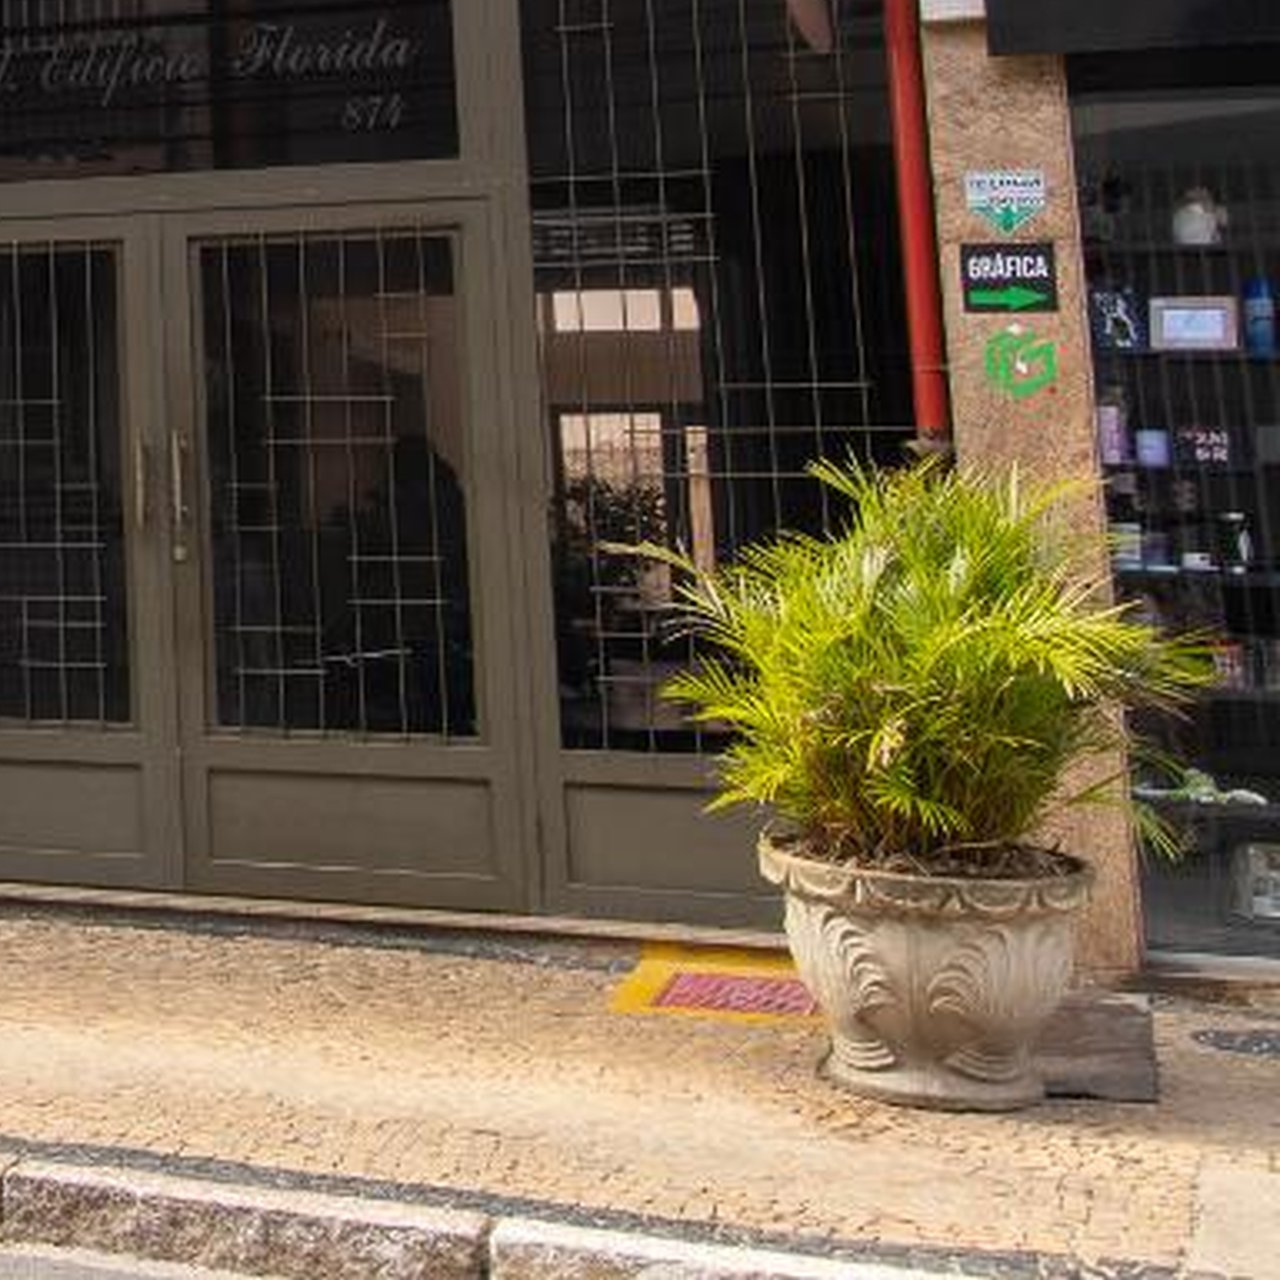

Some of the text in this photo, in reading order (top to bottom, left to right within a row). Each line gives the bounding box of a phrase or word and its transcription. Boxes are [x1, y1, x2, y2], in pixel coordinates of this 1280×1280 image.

[230, 19, 413, 77] Florida
[342, 92, 406, 131] 874
[968, 252, 1049, 280] GRÁFICA
